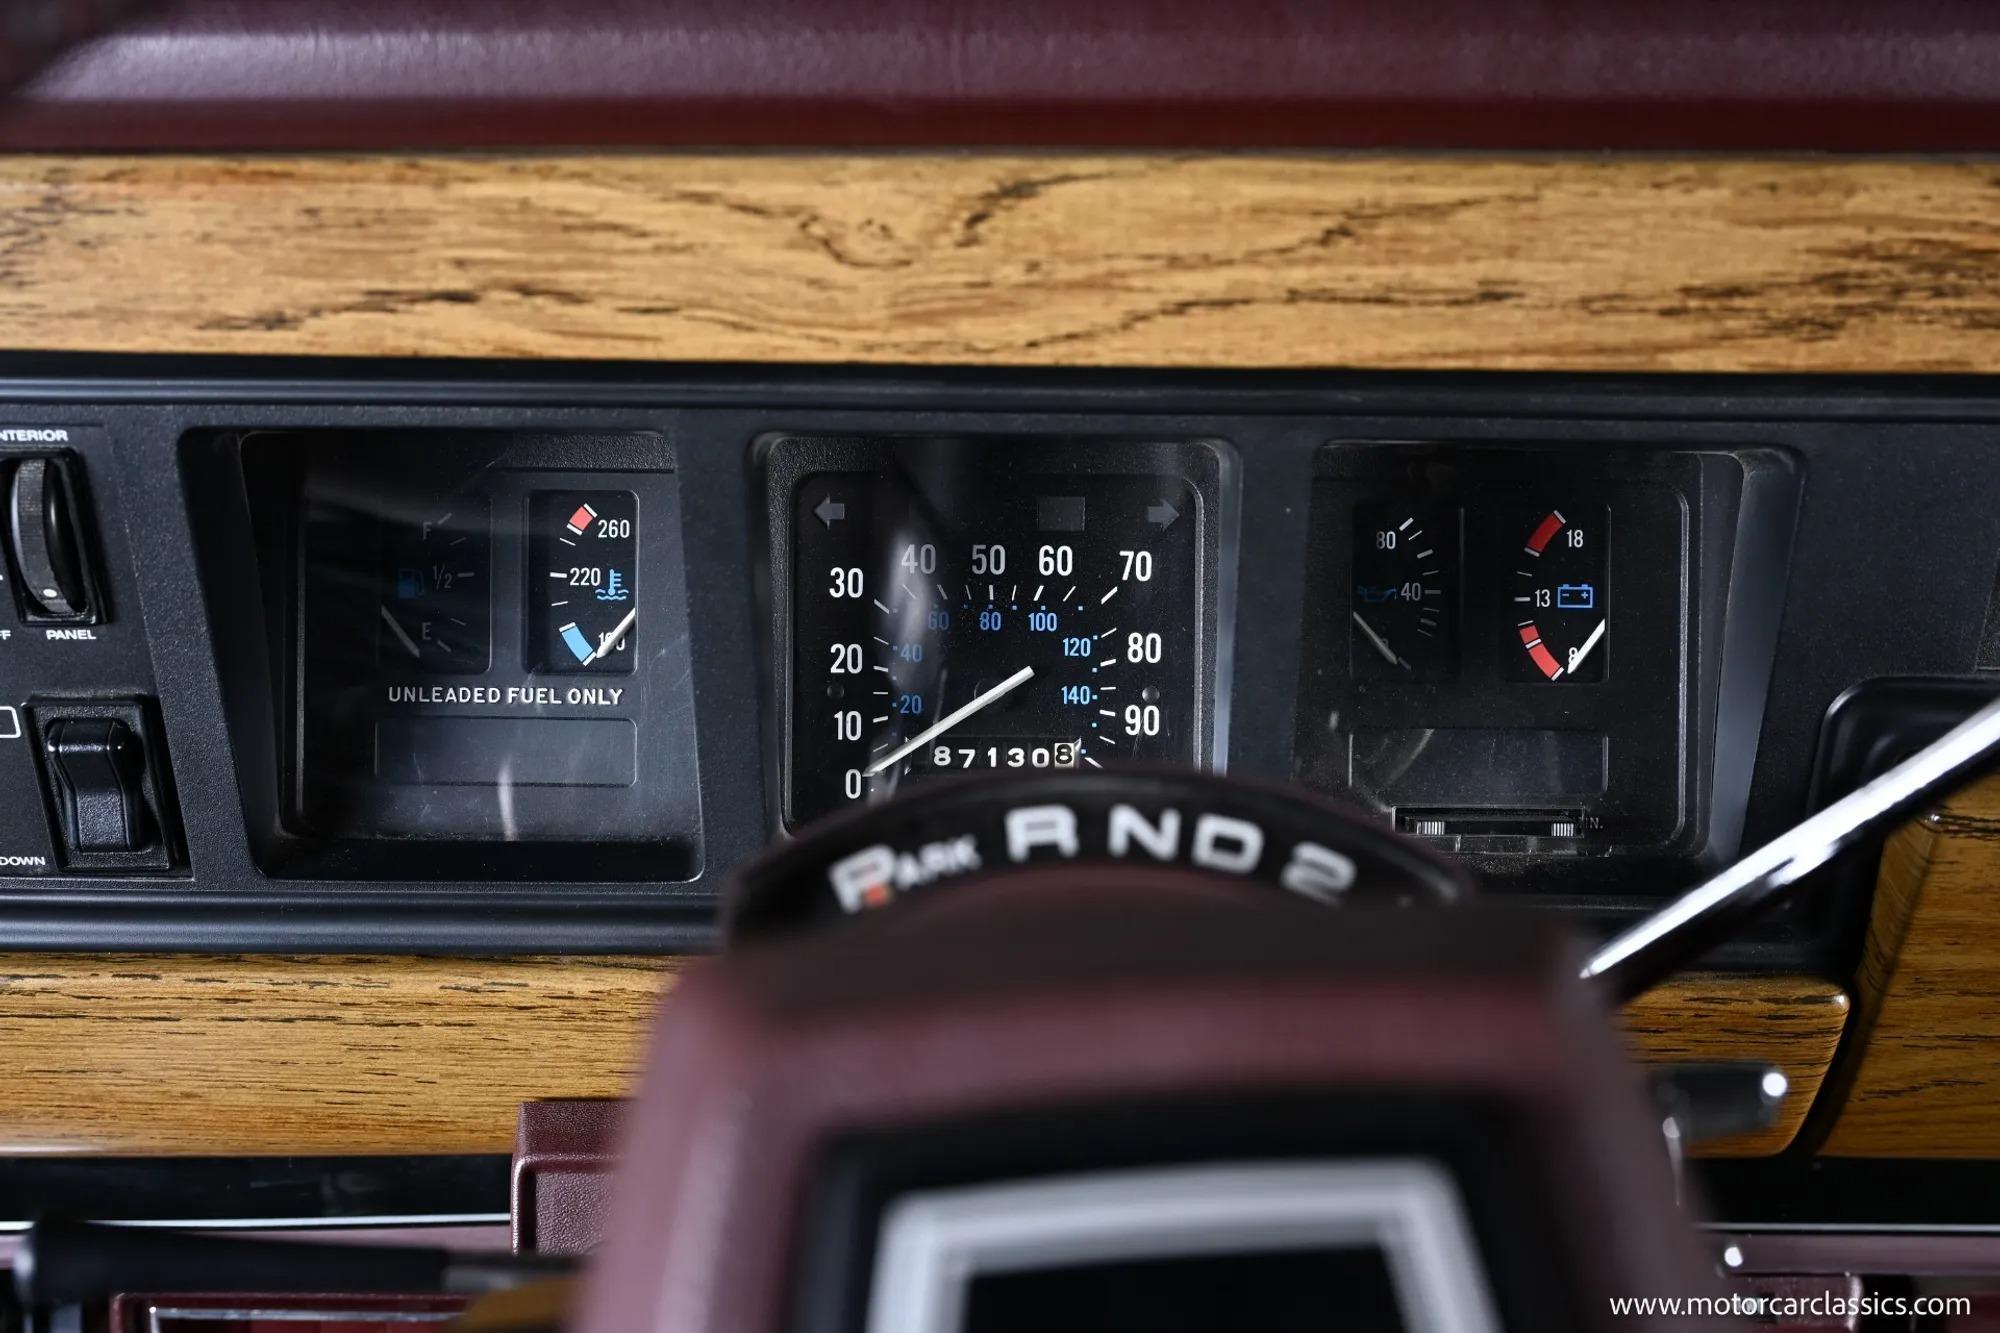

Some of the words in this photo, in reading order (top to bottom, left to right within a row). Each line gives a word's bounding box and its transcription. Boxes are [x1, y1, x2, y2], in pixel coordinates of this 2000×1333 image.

[422, 522, 432, 541] F
[598, 519, 630, 538] 260
[1566, 529, 1584, 548] 18
[1376, 531, 1396, 550] 80
[901, 543, 937, 575] 40
[971, 544, 1006, 576] 50
[1038, 544, 1073, 576] 60
[1119, 550, 1153, 582] 70
[569, 567, 601, 586] 220
[828, 567, 864, 599] 30
[1400, 582, 1422, 601] 40
[1534, 589, 1551, 608] 13
[928, 611, 949, 631] 60
[979, 611, 1001, 631] 80
[1028, 612, 1058, 632] 100
[45, 629, 97, 640] PANEL
[422, 622, 432, 641] E
[900, 644, 922, 663] 40
[1062, 637, 1091, 657] 120
[1127, 632, 1162, 663] 80
[830, 643, 863, 674] 20
[388, 686, 501, 703] UNLEADED
[508, 687, 562, 704] FUEL
[568, 688, 624, 705] ONLY
[900, 695, 922, 714] 20
[1061, 686, 1091, 705] 140
[833, 711, 862, 741] 10
[1125, 705, 1160, 736] 90
[845, 769, 862, 799] 0
[0, 856, 46, 866] DOWN
[830, 835, 982, 913] PARK
[1005, 804, 1078, 862] R
[1109, 804, 1181, 861] N
[1192, 813, 1264, 874] D
[1280, 841, 1357, 908] 2
